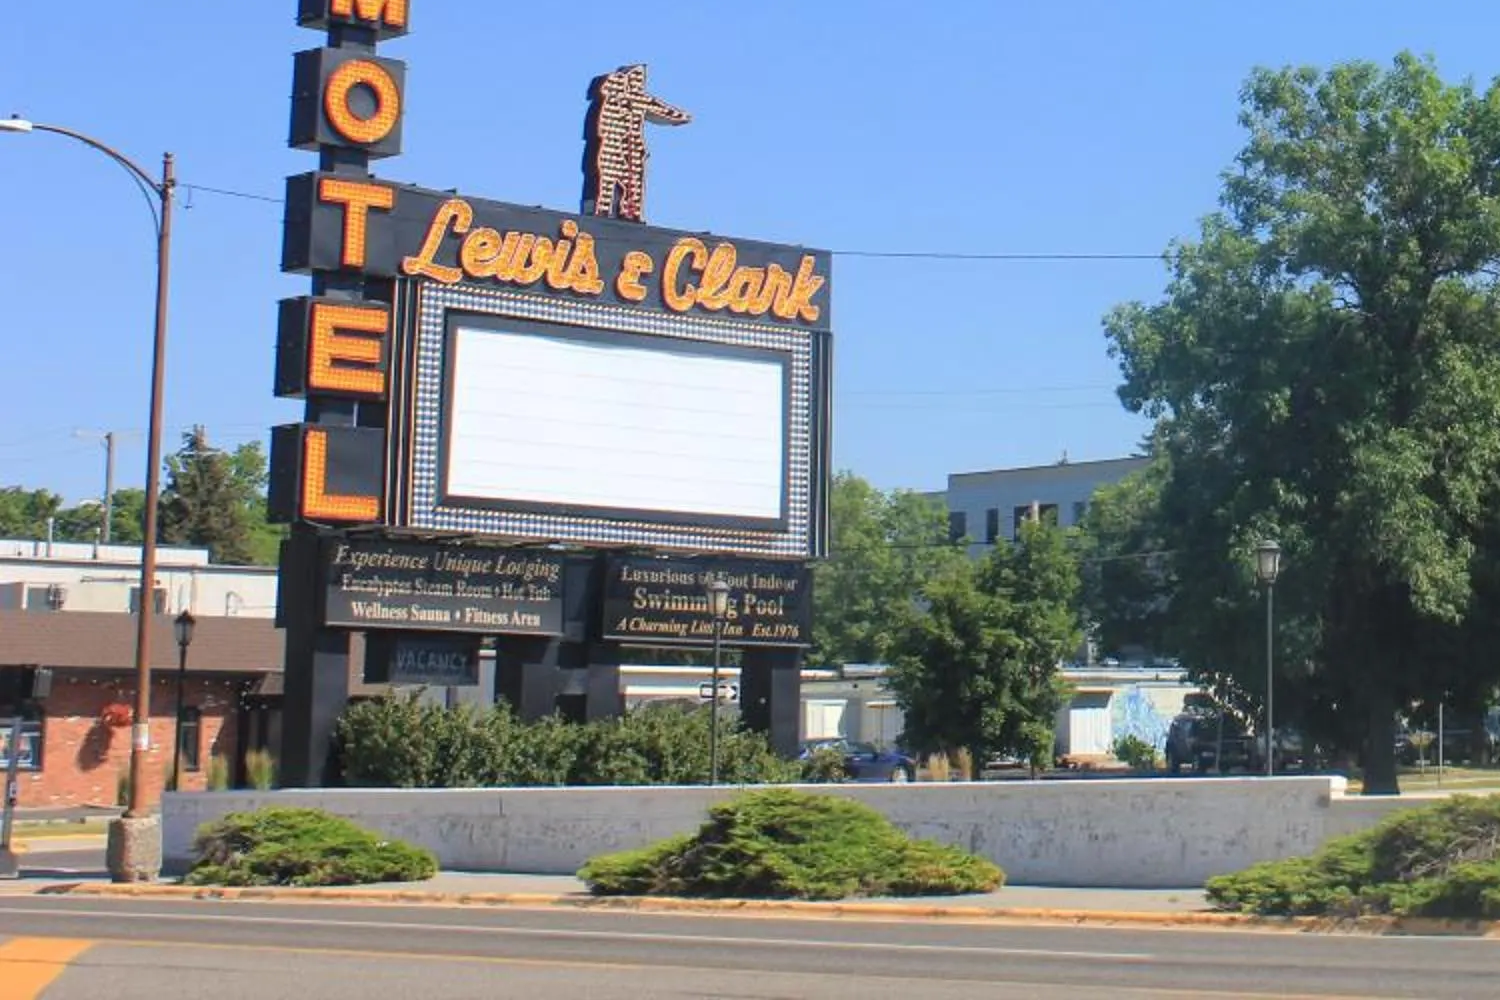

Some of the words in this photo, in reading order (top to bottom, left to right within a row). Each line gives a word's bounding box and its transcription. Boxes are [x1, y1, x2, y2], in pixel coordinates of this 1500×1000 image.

[402, 199, 604, 295] Lewis
[663, 236, 825, 323] Clark
[334, 544, 429, 571] Experience
[433, 551, 492, 577] Unique
[495, 555, 561, 583] Lodging
[414, 577, 453, 597] Steam
[620, 565, 694, 585] Luxurious
[752, 573, 798, 592] Indoor
[351, 600, 409, 620] Wellness
[411, 604, 451, 623] Sauna
[464, 606, 509, 626] Fitness
[511, 610, 541, 627] Area
[632, 586, 739, 619] Swimmg
[743, 593, 785, 617] Pool
[616, 616, 628, 631] A
[629, 616, 689, 637] Charming
[722, 620, 744, 636] Inn
[395, 647, 468, 670] VACANCY
